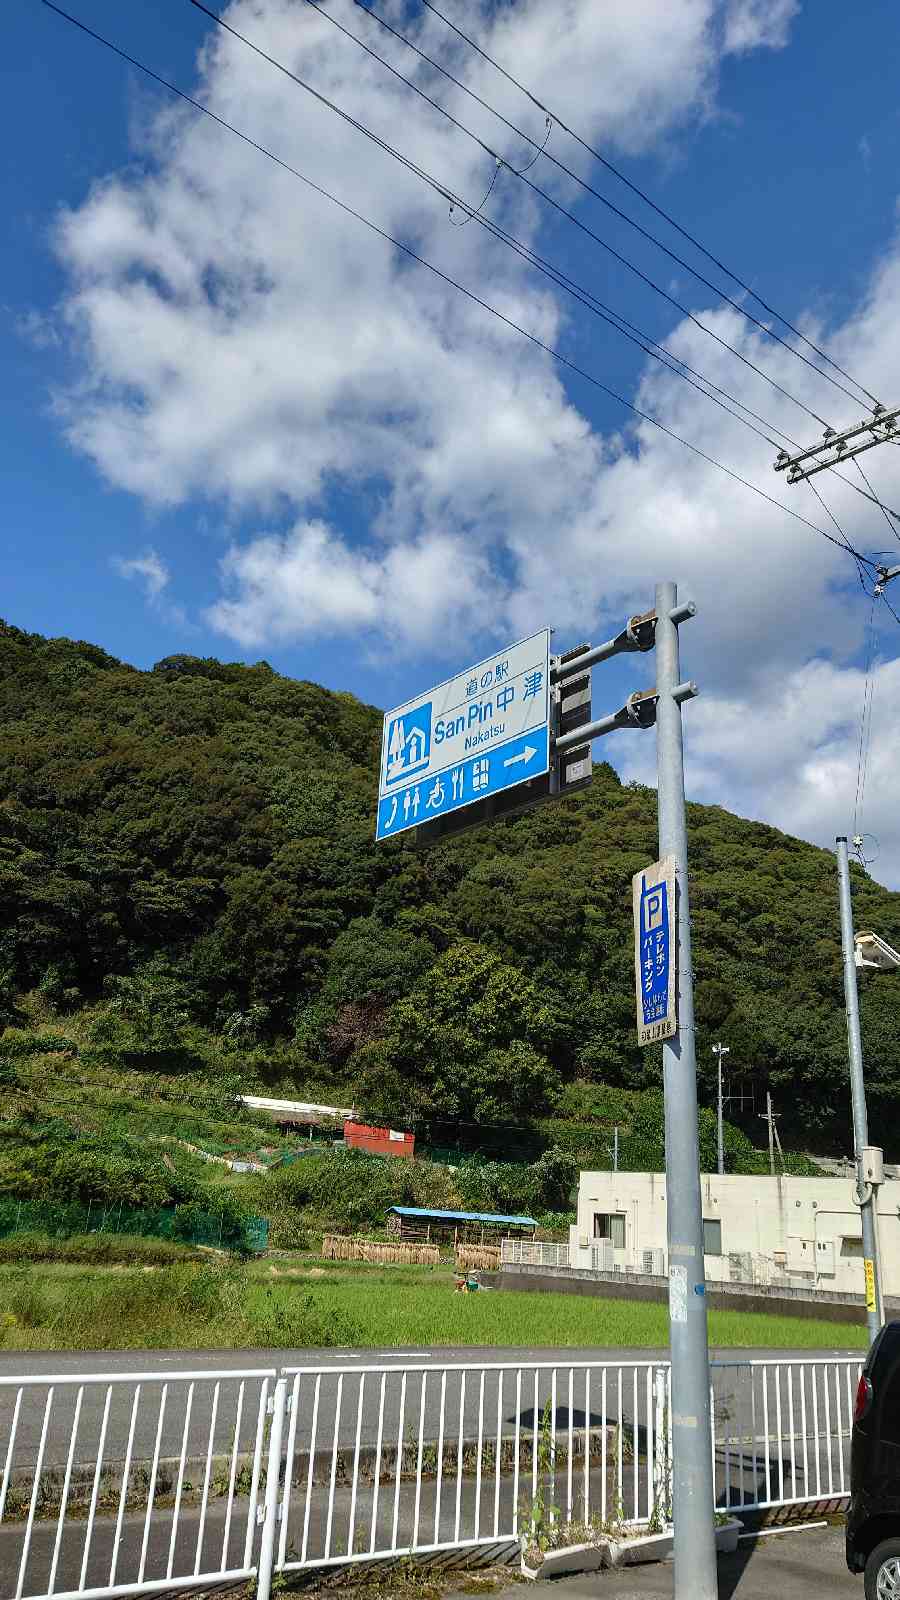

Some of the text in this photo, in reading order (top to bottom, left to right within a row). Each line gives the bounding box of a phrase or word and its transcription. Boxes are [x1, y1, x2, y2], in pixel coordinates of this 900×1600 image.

[465, 661, 509, 697] 道の駅
[464, 723, 506, 750] Nakatsu
[648, 896, 659, 928] P
